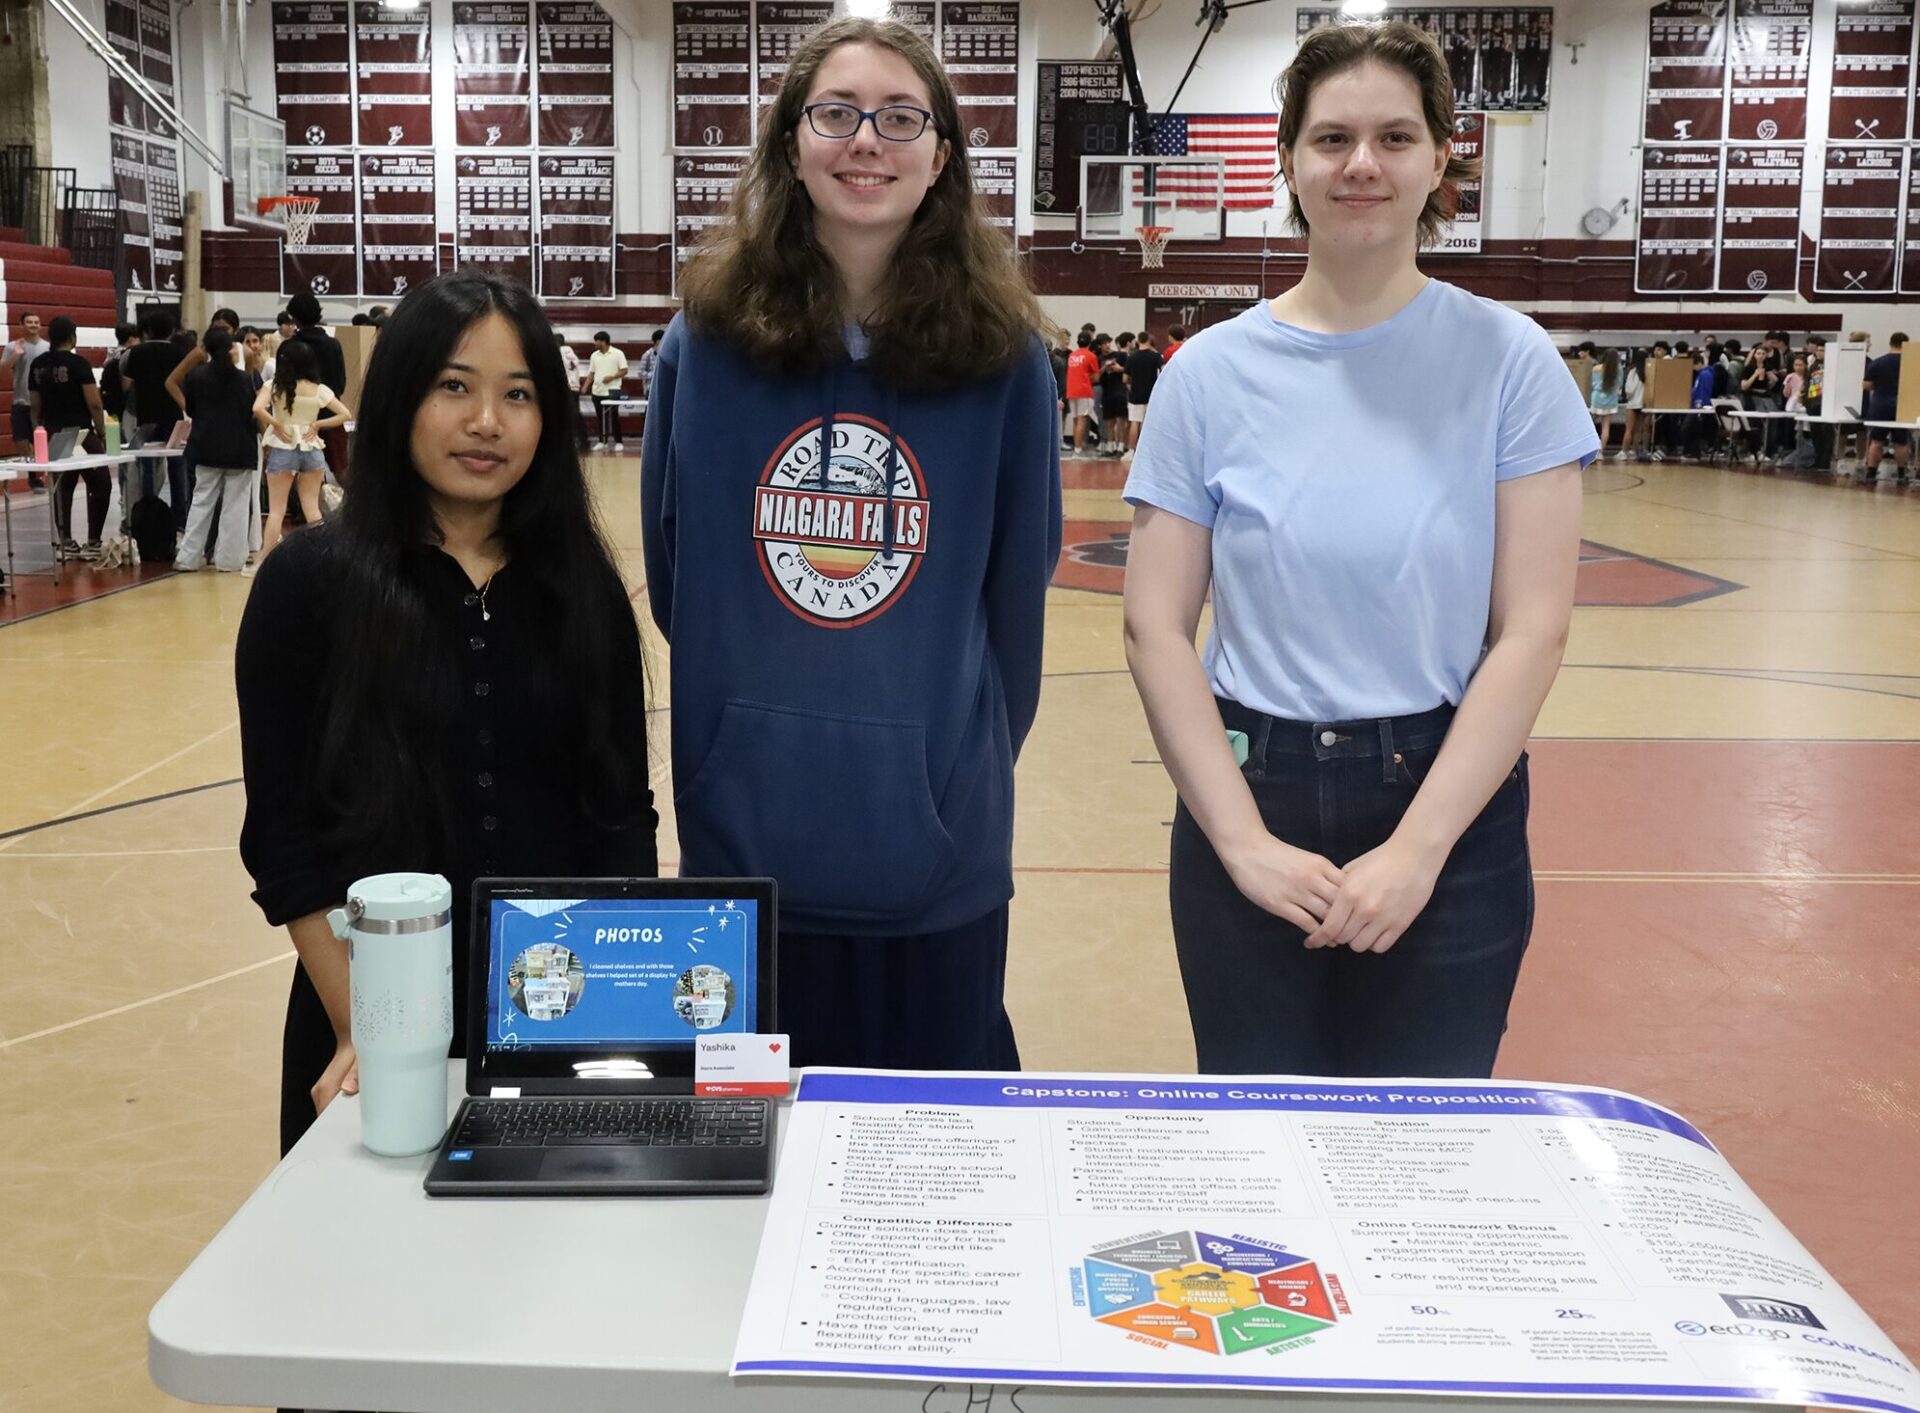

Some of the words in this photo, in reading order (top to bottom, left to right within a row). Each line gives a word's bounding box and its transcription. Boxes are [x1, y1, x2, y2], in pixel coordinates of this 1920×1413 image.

[1451, 142, 1478, 154] UEST
[1455, 213, 1478, 221] SCORE
[1444, 238, 1477, 248] 2016
[1151, 286, 1219, 296] EMERGENCY
[1224, 287, 1256, 297] ONLY
[1179, 306, 1195, 326] 17
[780, 430, 849, 483] ROAD
[759, 493, 854, 540] NIAGARA
[794, 551, 820, 582] YOURS
[822, 578, 834, 588] TO
[838, 558, 881, 589] DISCOVER
[776, 551, 900, 611] CANADA
[594, 927, 663, 945] PHOTOS
[700, 1043, 736, 1052] Yashika
[1001, 1086, 1129, 1099] Capstone:
[1138, 1089, 1219, 1099] Online
[1227, 1090, 1381, 1103] Coursework
[1388, 1093, 1537, 1106] Proposition
[842, 1216, 931, 1224] Competitive
[935, 1219, 1012, 1227] Difference
[831, 1230, 866, 1238] Offer
[870, 1234, 950, 1242] opportunity
[1231, 1233, 1288, 1251] REALISTIC
[830, 1240, 921, 1249] conventional
[842, 1256, 876, 1264] EMT
[826, 1265, 887, 1274] Account
[890, 1267, 910, 1275] for
[913, 1269, 970, 1277] specific
[824, 1274, 883, 1282] courses
[933, 1278, 999, 1287] standard
[838, 1293, 892, 1303] Coding
[955, 1307, 1003, 1315] media
[818, 1320, 858, 1329] Have
[863, 1322, 888, 1330] the
[892, 1324, 944, 1332] variety
[1710, 1323, 1790, 1341] ed2go
[815, 1330, 883, 1340] flexibility
[913, 1334, 972, 1343] student
[1126, 1332, 1170, 1350] SOCIAL
[814, 1341, 902, 1351] exploration
